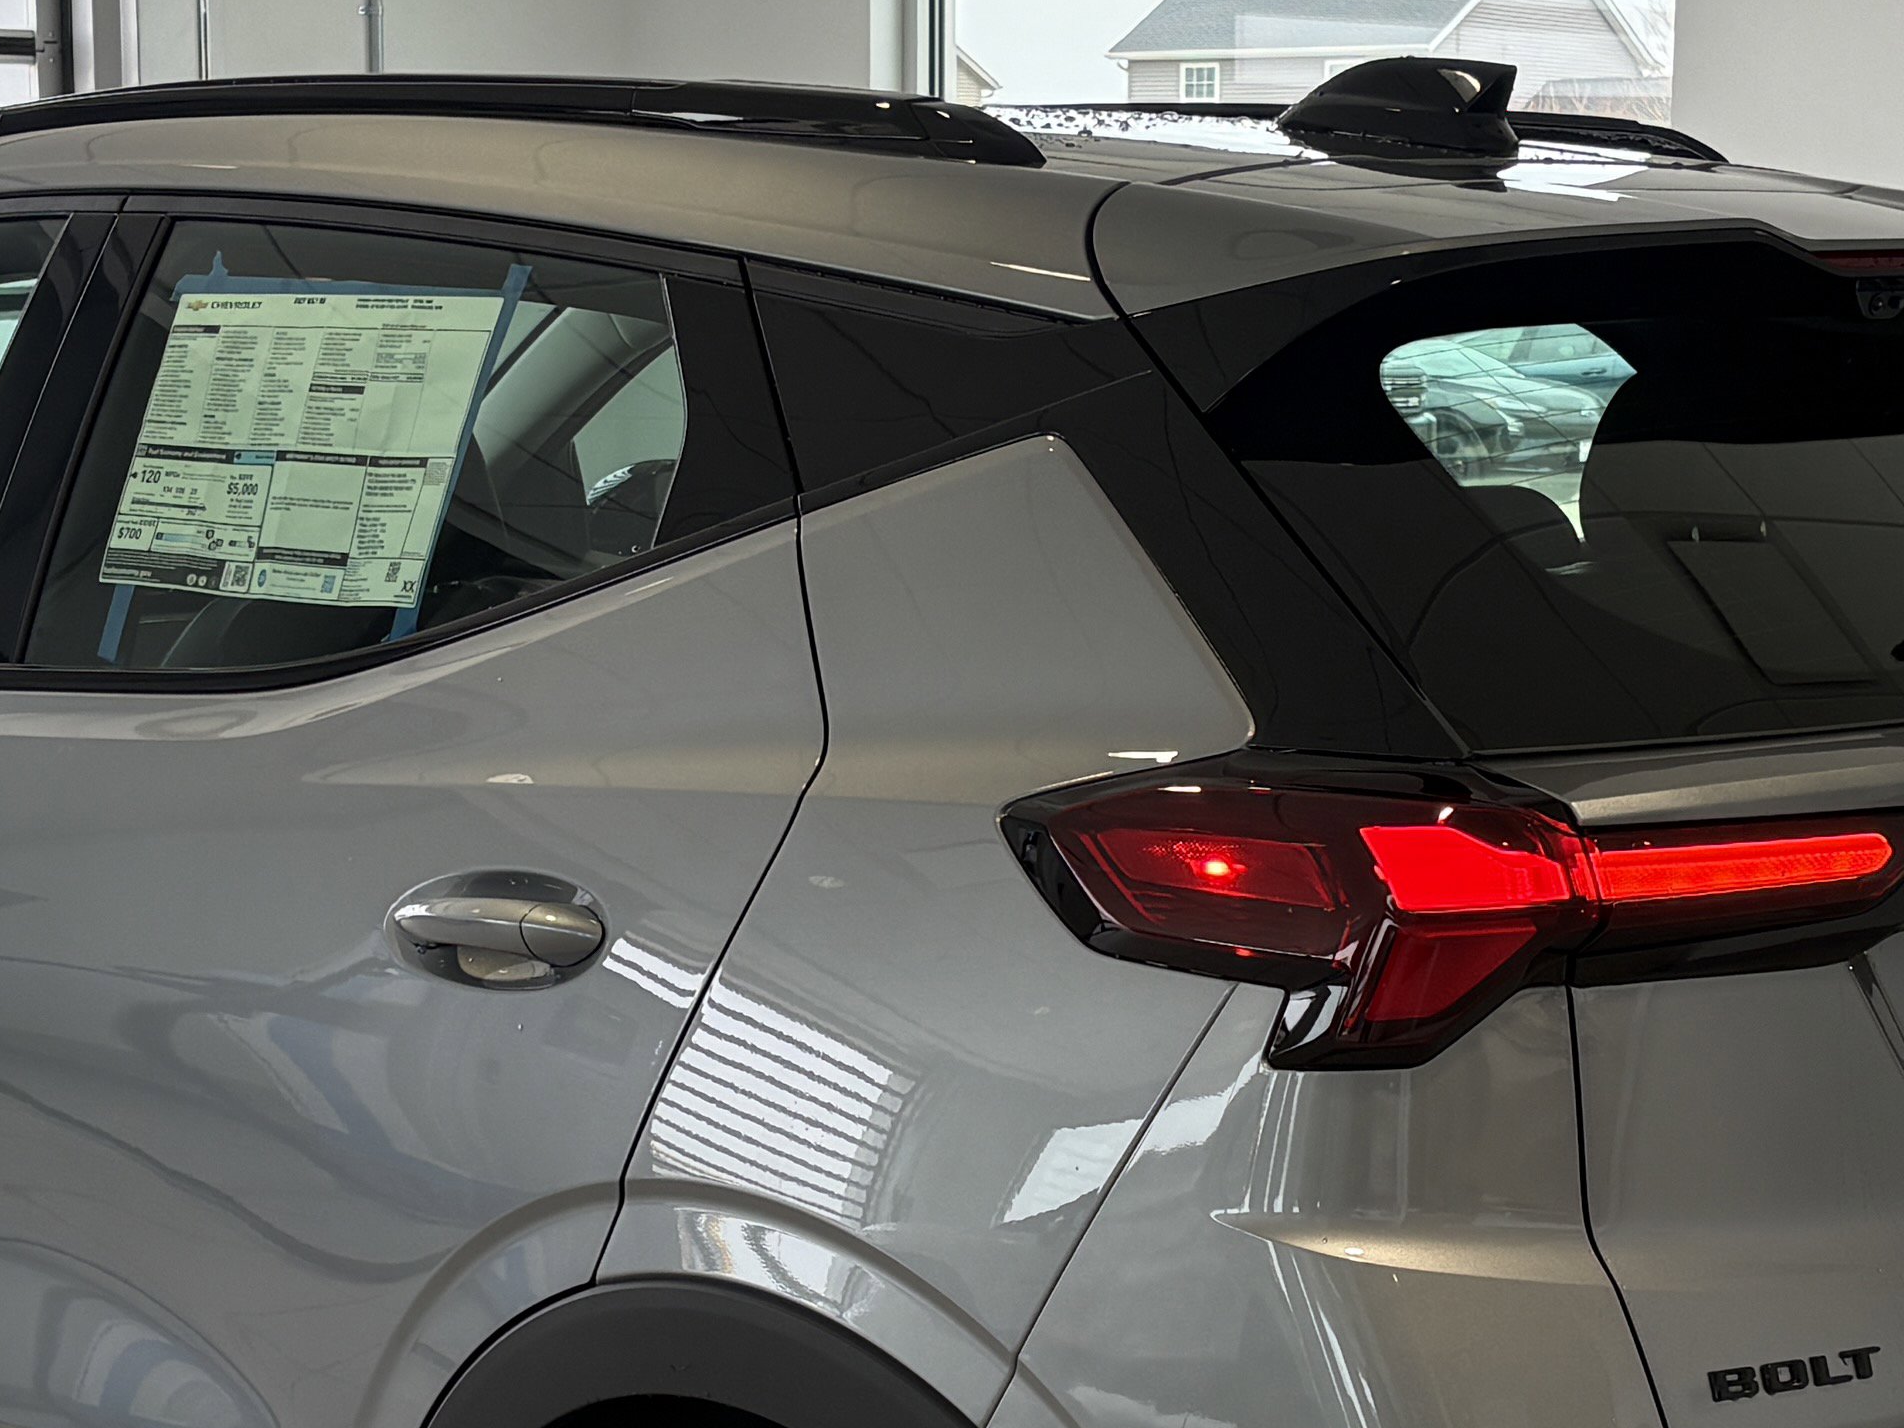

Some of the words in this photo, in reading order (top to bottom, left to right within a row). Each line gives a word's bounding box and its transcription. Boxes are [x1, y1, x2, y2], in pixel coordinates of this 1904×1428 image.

[211, 301, 263, 310] CHEVROLET
[141, 470, 161, 484] 120
[227, 482, 259, 496] $5,000
[117, 528, 142, 540] $700
[1707, 1346, 1881, 1403] BOLT
